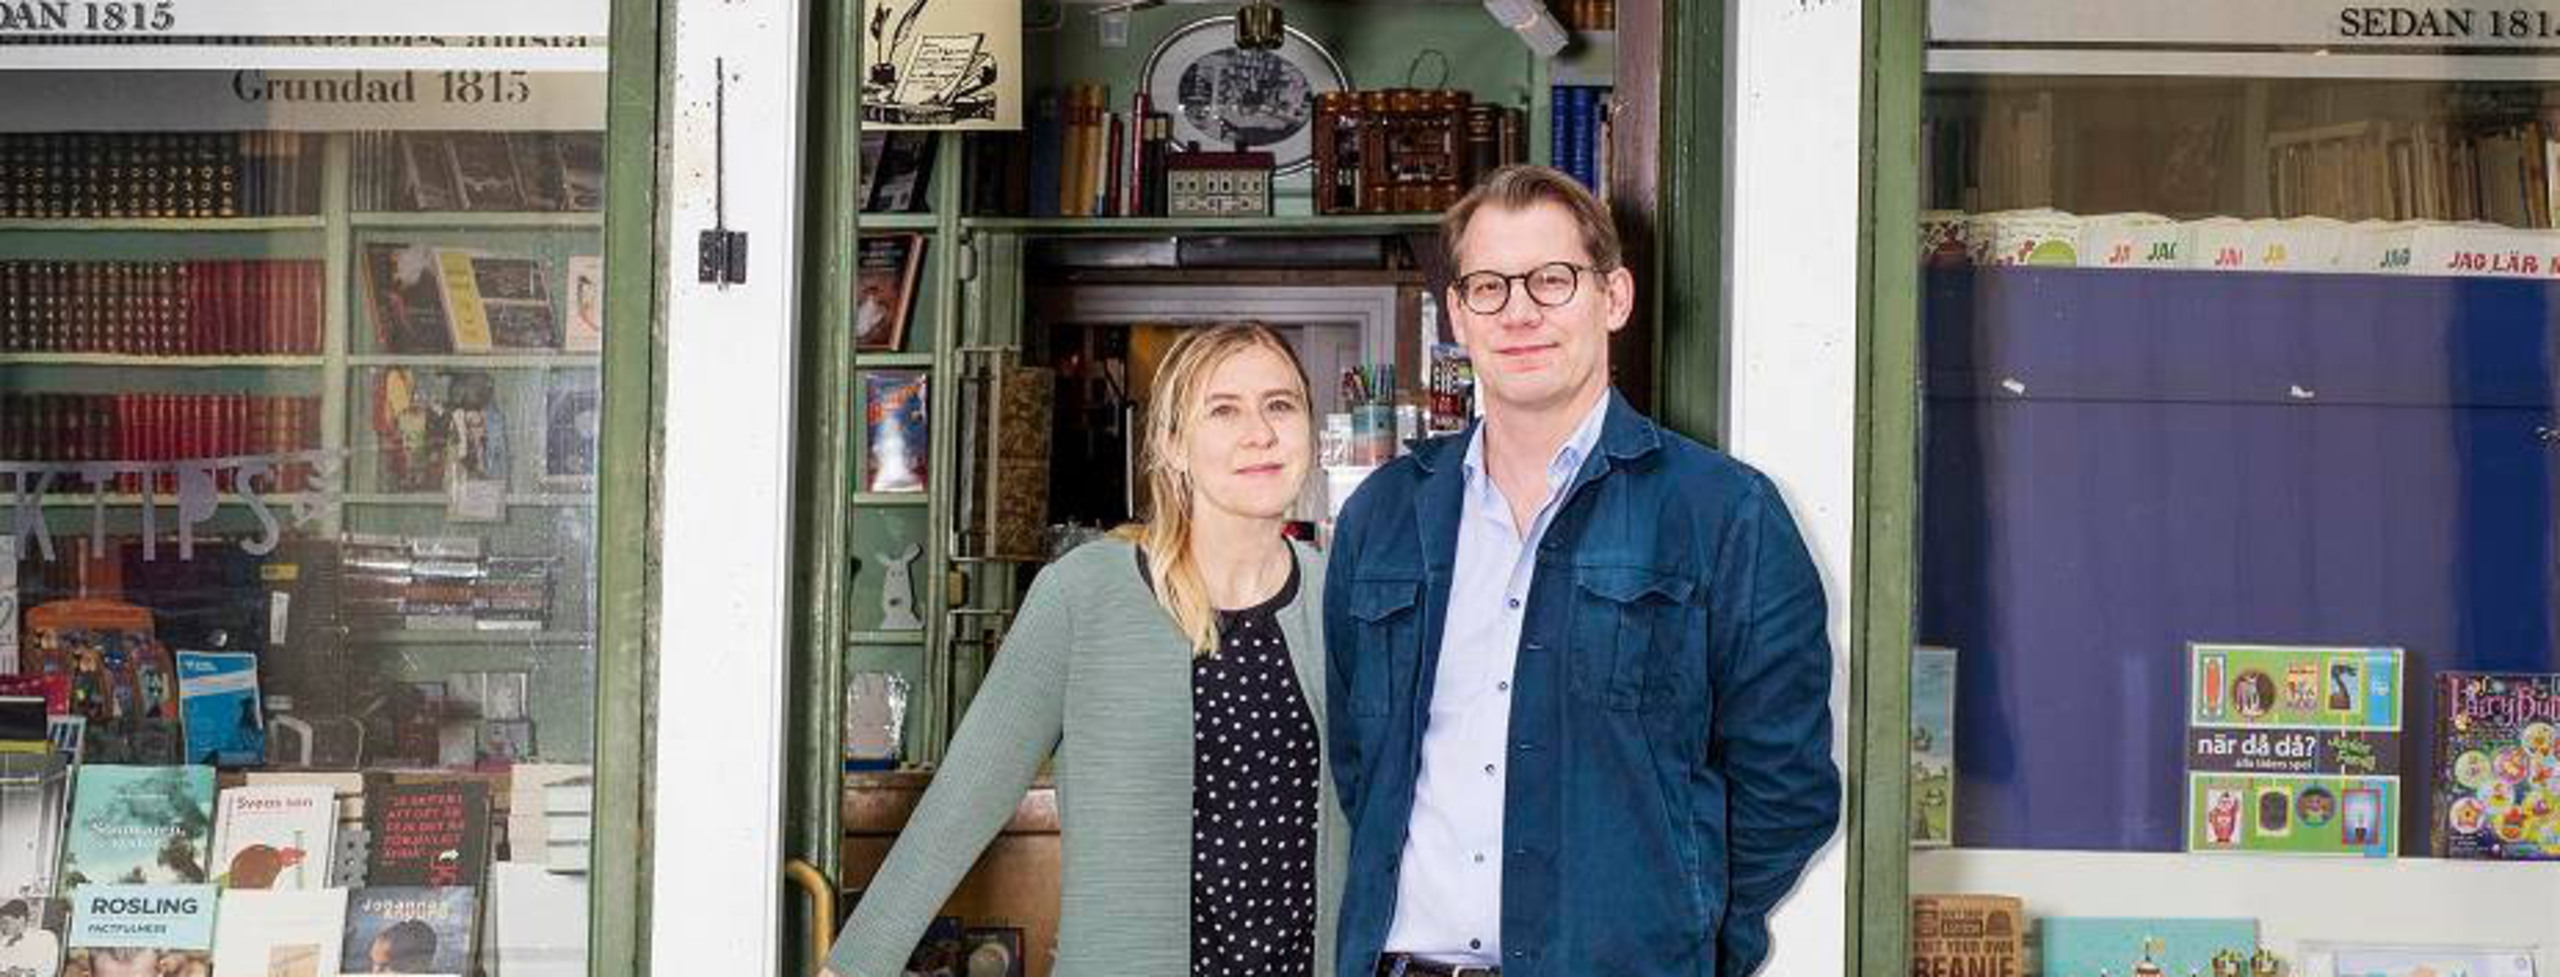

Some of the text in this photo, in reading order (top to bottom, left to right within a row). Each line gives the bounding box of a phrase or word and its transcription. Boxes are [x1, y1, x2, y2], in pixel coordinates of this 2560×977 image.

[85, 2, 175, 31] 1815
[2340, 7, 2560, 38] SEDAN 181
[232, 69, 530, 103] Grundad 1815
[2447, 251, 2486, 270] JAG
[2488, 249, 2539, 274] LÄR
[2197, 733, 2316, 757] när då då?
[90, 897, 199, 915] ROSLING
